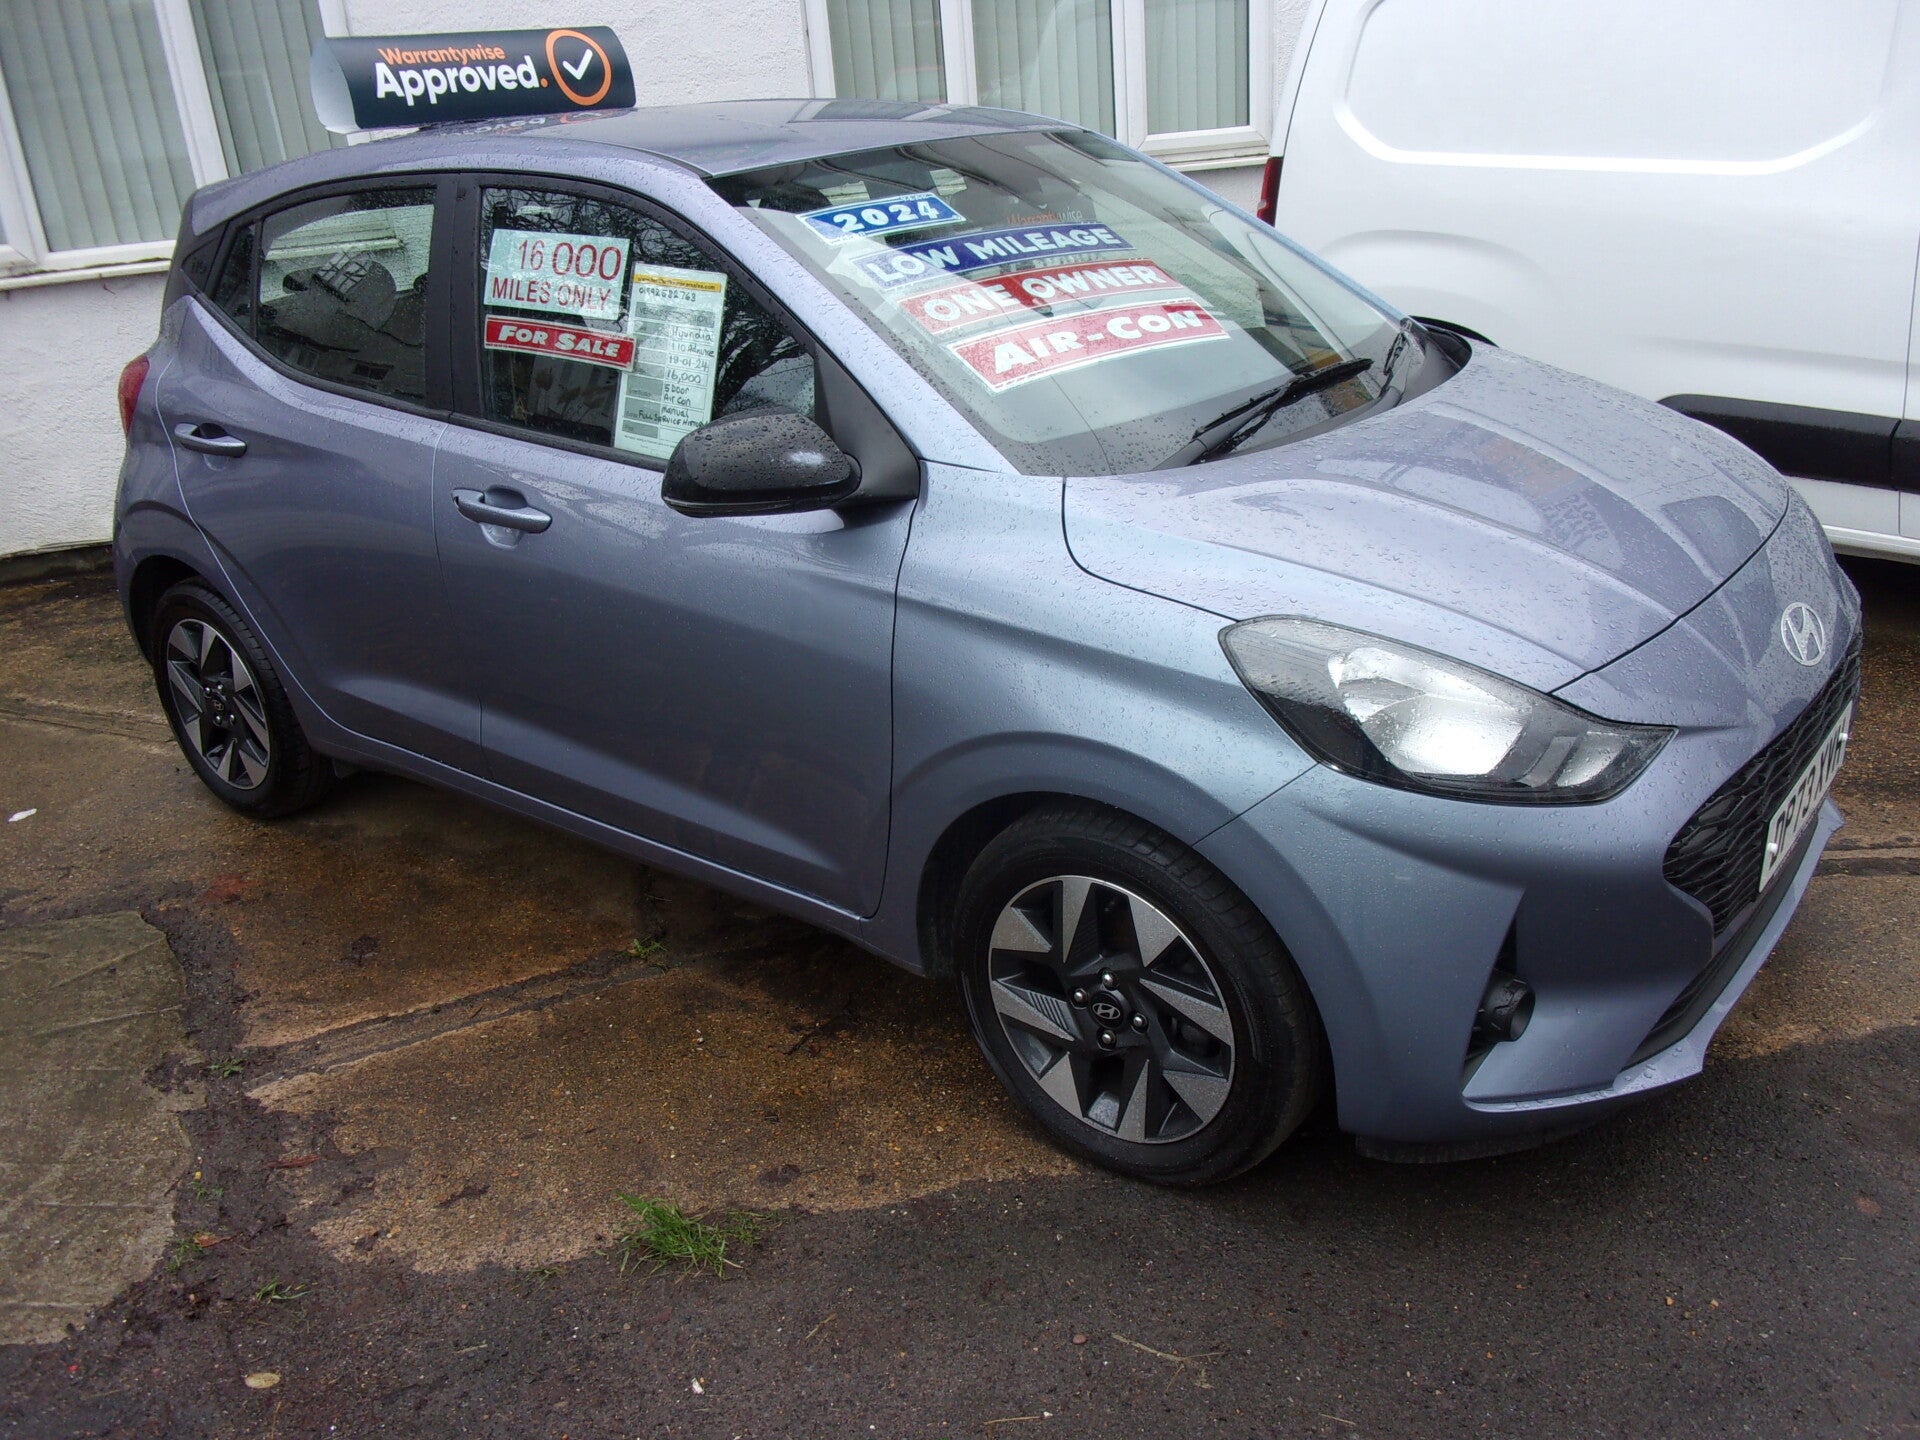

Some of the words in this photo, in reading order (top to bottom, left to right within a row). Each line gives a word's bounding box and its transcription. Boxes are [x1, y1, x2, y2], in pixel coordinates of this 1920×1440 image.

[378, 44, 506, 65] Warrantywise
[375, 55, 549, 107] Approved.
[833, 200, 940, 233] 2024
[518, 240, 545, 271] 16
[552, 242, 621, 281] 000
[865, 245, 961, 282] LOW
[965, 228, 1121, 261] MILEAGE
[492, 276, 552, 304] MILES
[557, 283, 611, 311] ONLY
[923, 284, 1021, 322] ONE
[1022, 264, 1167, 300] OWNER
[498, 325, 549, 346] FOR
[555, 332, 620, 358] SALE
[993, 309, 1204, 374] AIR-CON
[667, 369, 701, 384] 16,000
